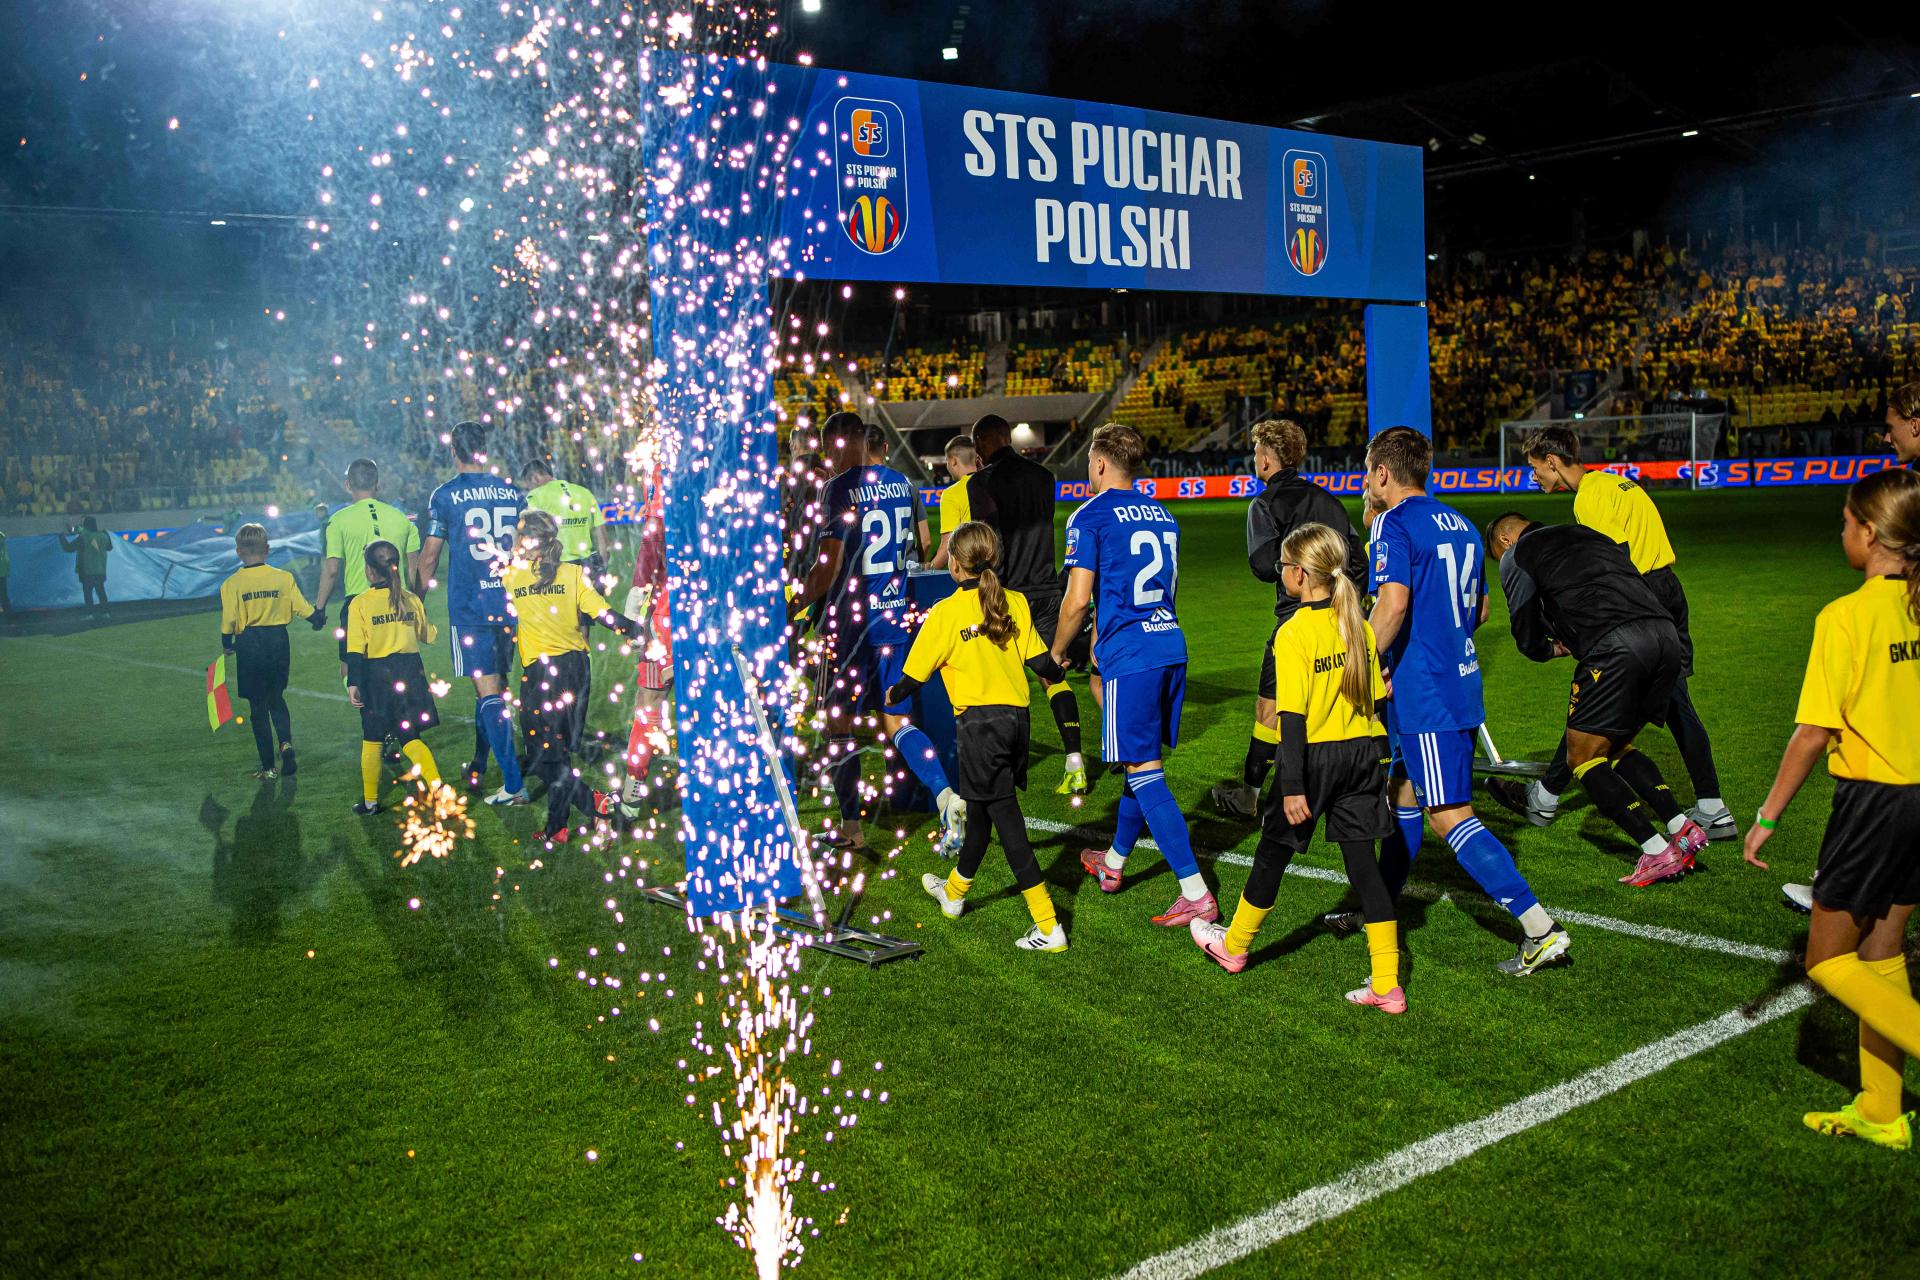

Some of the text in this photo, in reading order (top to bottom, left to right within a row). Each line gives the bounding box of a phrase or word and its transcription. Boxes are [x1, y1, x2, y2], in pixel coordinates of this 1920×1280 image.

[858, 122, 882, 145] STS
[963, 109, 1243, 200] STS PUCHAR
[846, 163, 863, 176] STS
[1297, 169, 1314, 188] STS
[858, 177, 887, 190] POLSKI
[1035, 198, 1191, 270] POLSKI
[1727, 458, 1908, 483] STS PUCH
[1060, 483, 1098, 498] POL
[1179, 476, 1206, 498] STS
[1230, 475, 1258, 497] STS
[1313, 474, 1368, 491] PUC
[451, 484, 518, 504] KAMIŃSKI
[920, 489, 945, 504] TS
[1431, 512, 1469, 532] KUN
[465, 507, 518, 561] 35
[861, 506, 912, 575] 25
[1130, 530, 1178, 607] 21
[480, 579, 502, 590] Bud
[1436, 543, 1478, 629] 14
[1314, 655, 1332, 674] GKS
